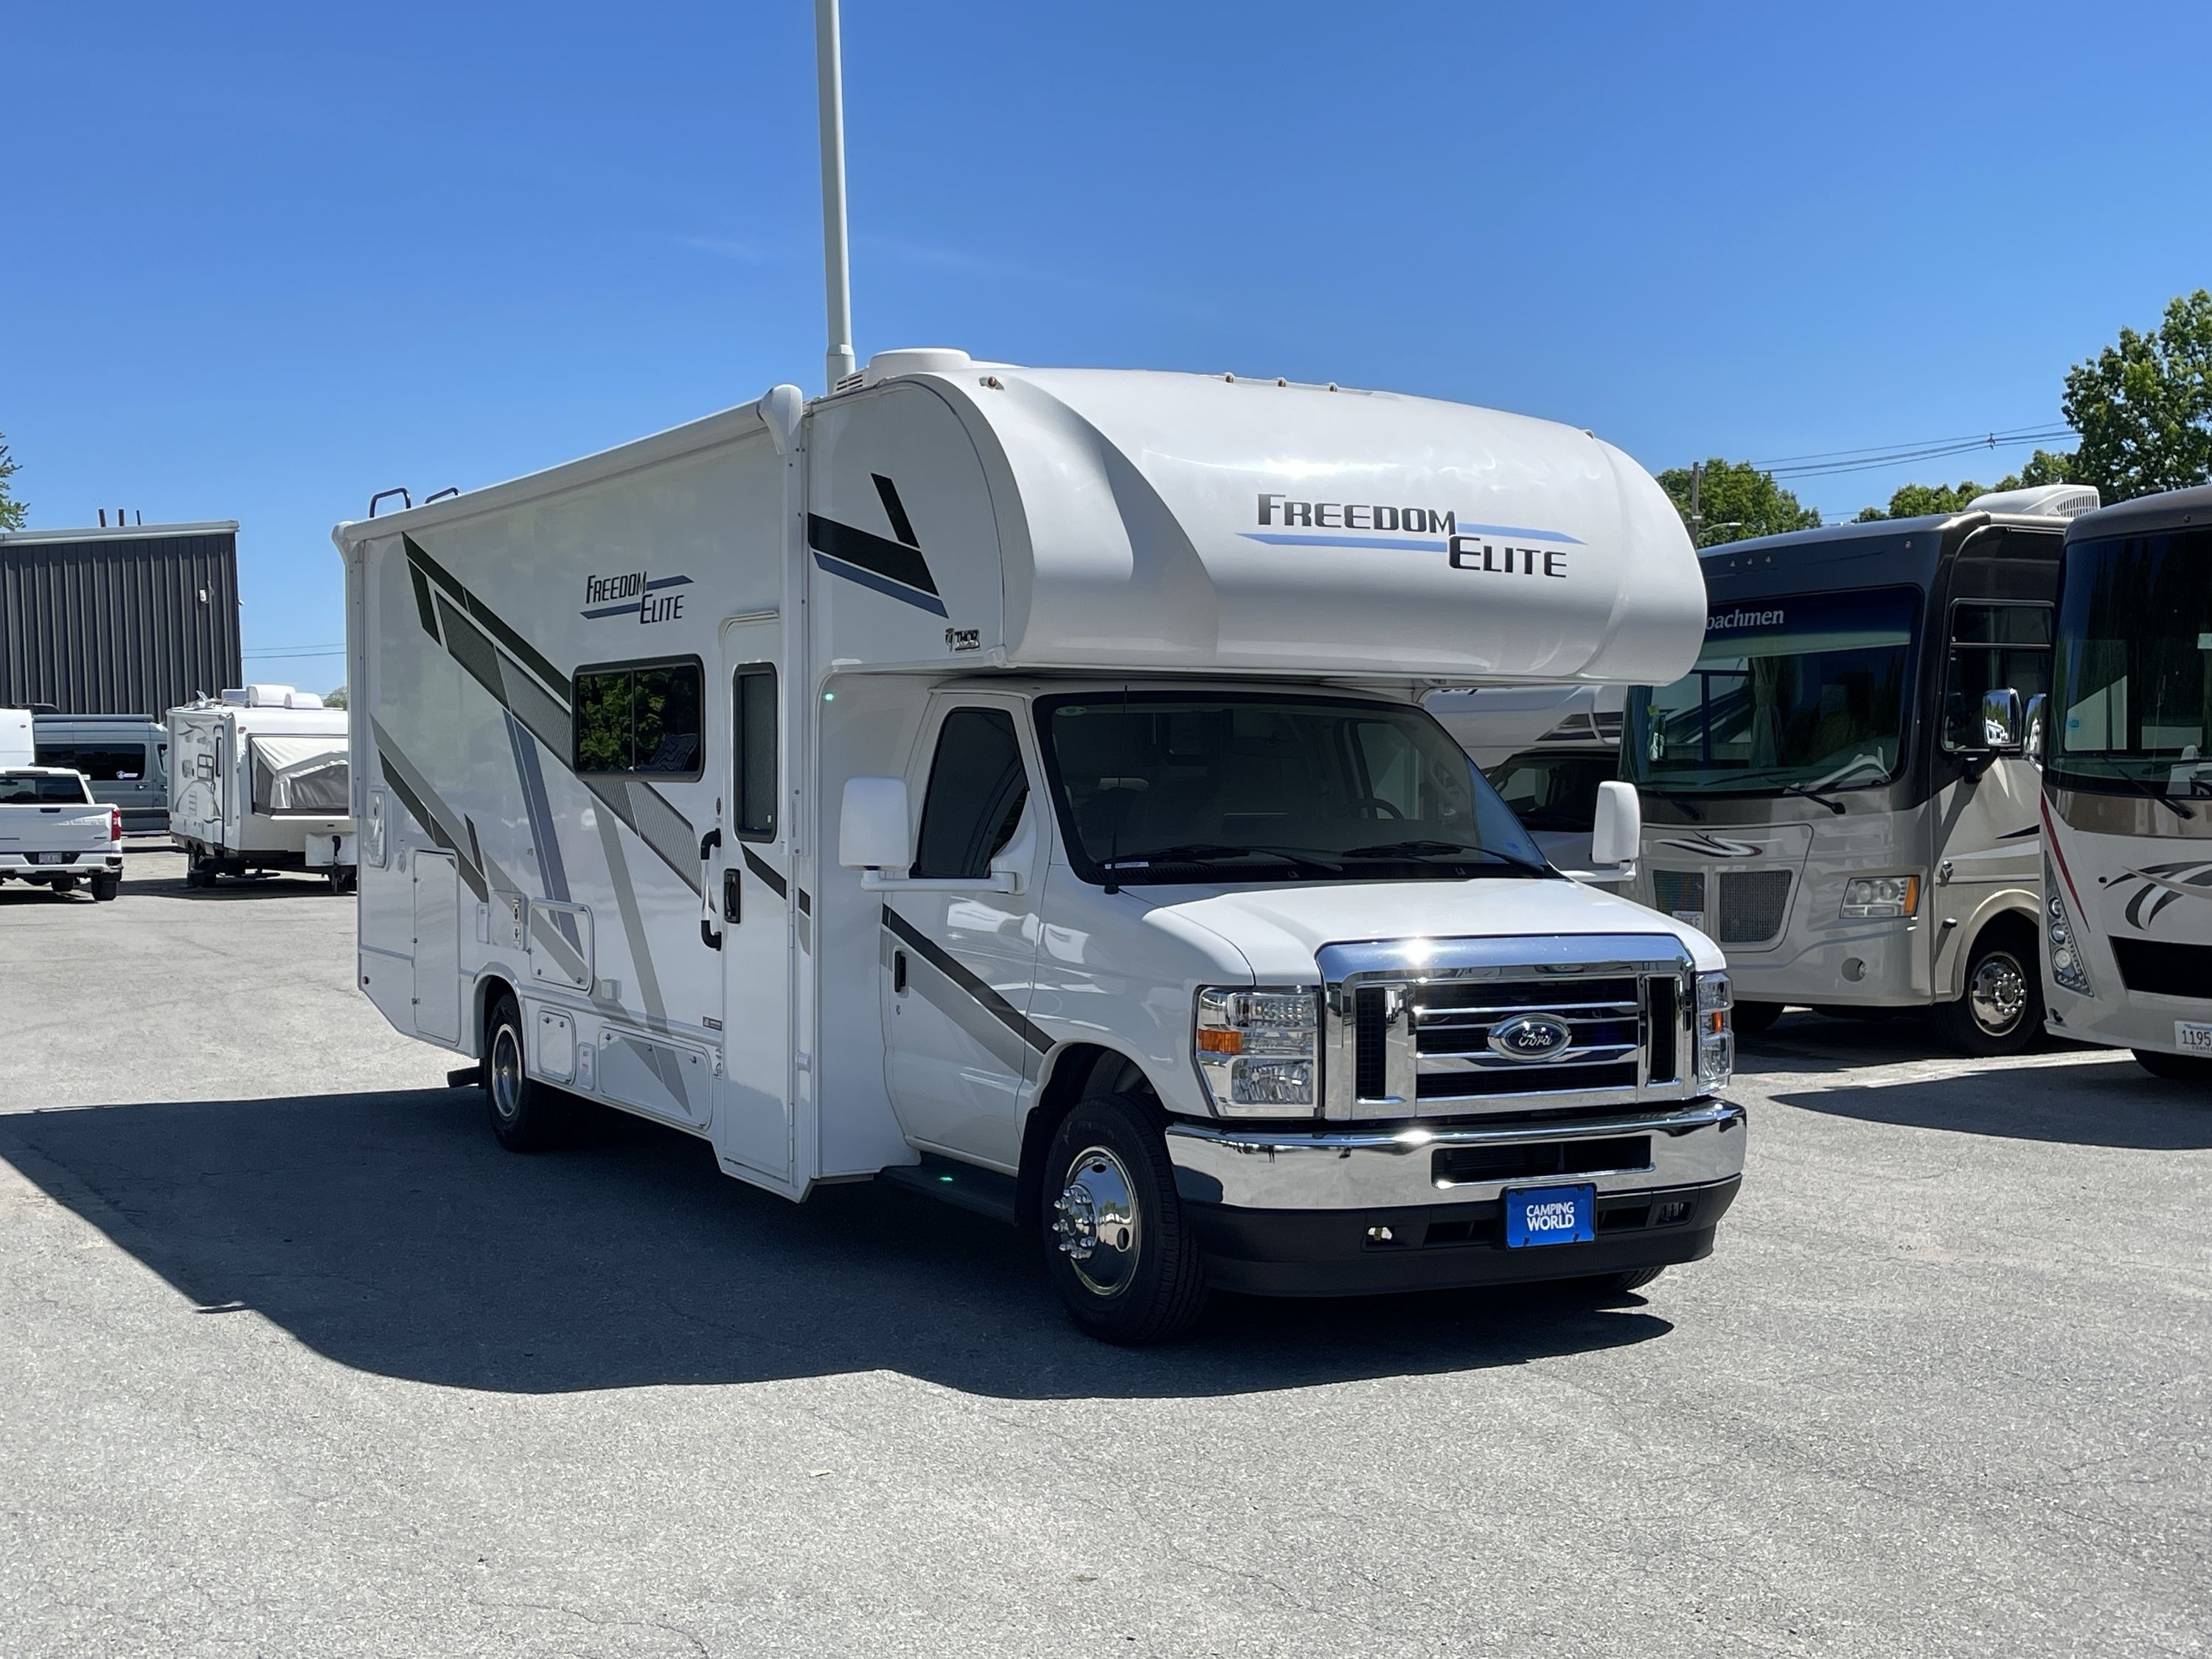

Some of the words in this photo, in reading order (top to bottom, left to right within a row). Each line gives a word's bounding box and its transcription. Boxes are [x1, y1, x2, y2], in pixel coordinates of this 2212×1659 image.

[1257, 493, 1456, 535] FREEDOM
[1449, 535, 1567, 578] ELITE
[585, 571, 647, 604] FREEDOM
[640, 594, 684, 625] ELITE
[1705, 609, 1784, 630] oachmen
[1519, 1029, 1554, 1047] Ford
[1526, 1201, 1574, 1217] CAMPING
[1527, 1214, 1575, 1231] WORLD
